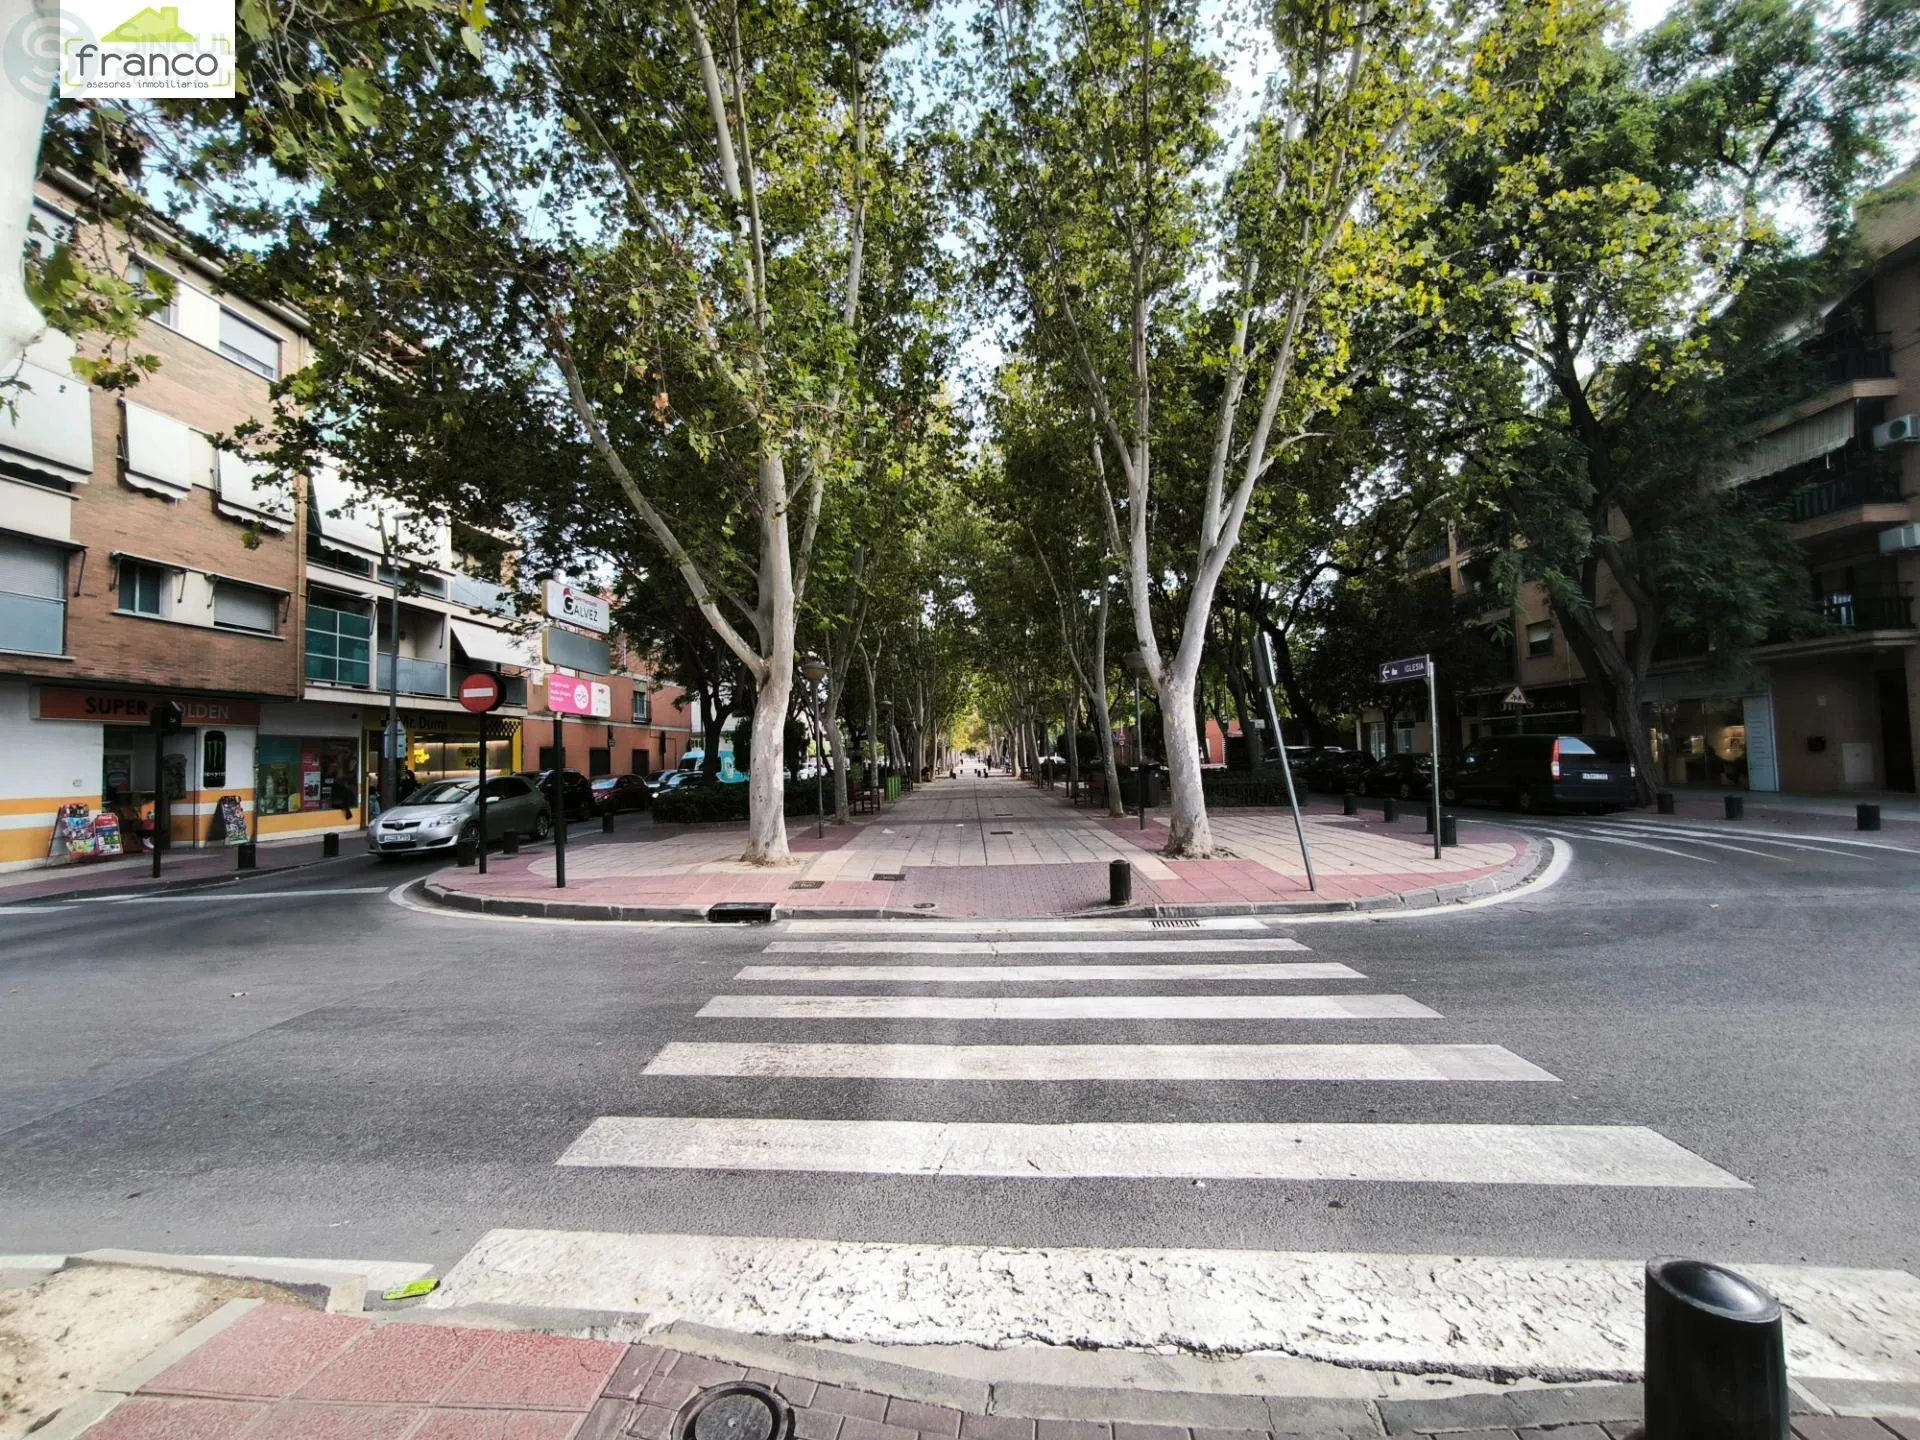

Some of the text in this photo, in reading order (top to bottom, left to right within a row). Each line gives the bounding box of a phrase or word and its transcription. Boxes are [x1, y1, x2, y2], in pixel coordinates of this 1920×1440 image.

[1404, 662, 1425, 673] IGLESIA
[85, 696, 230, 720] SUPER OLDEN
